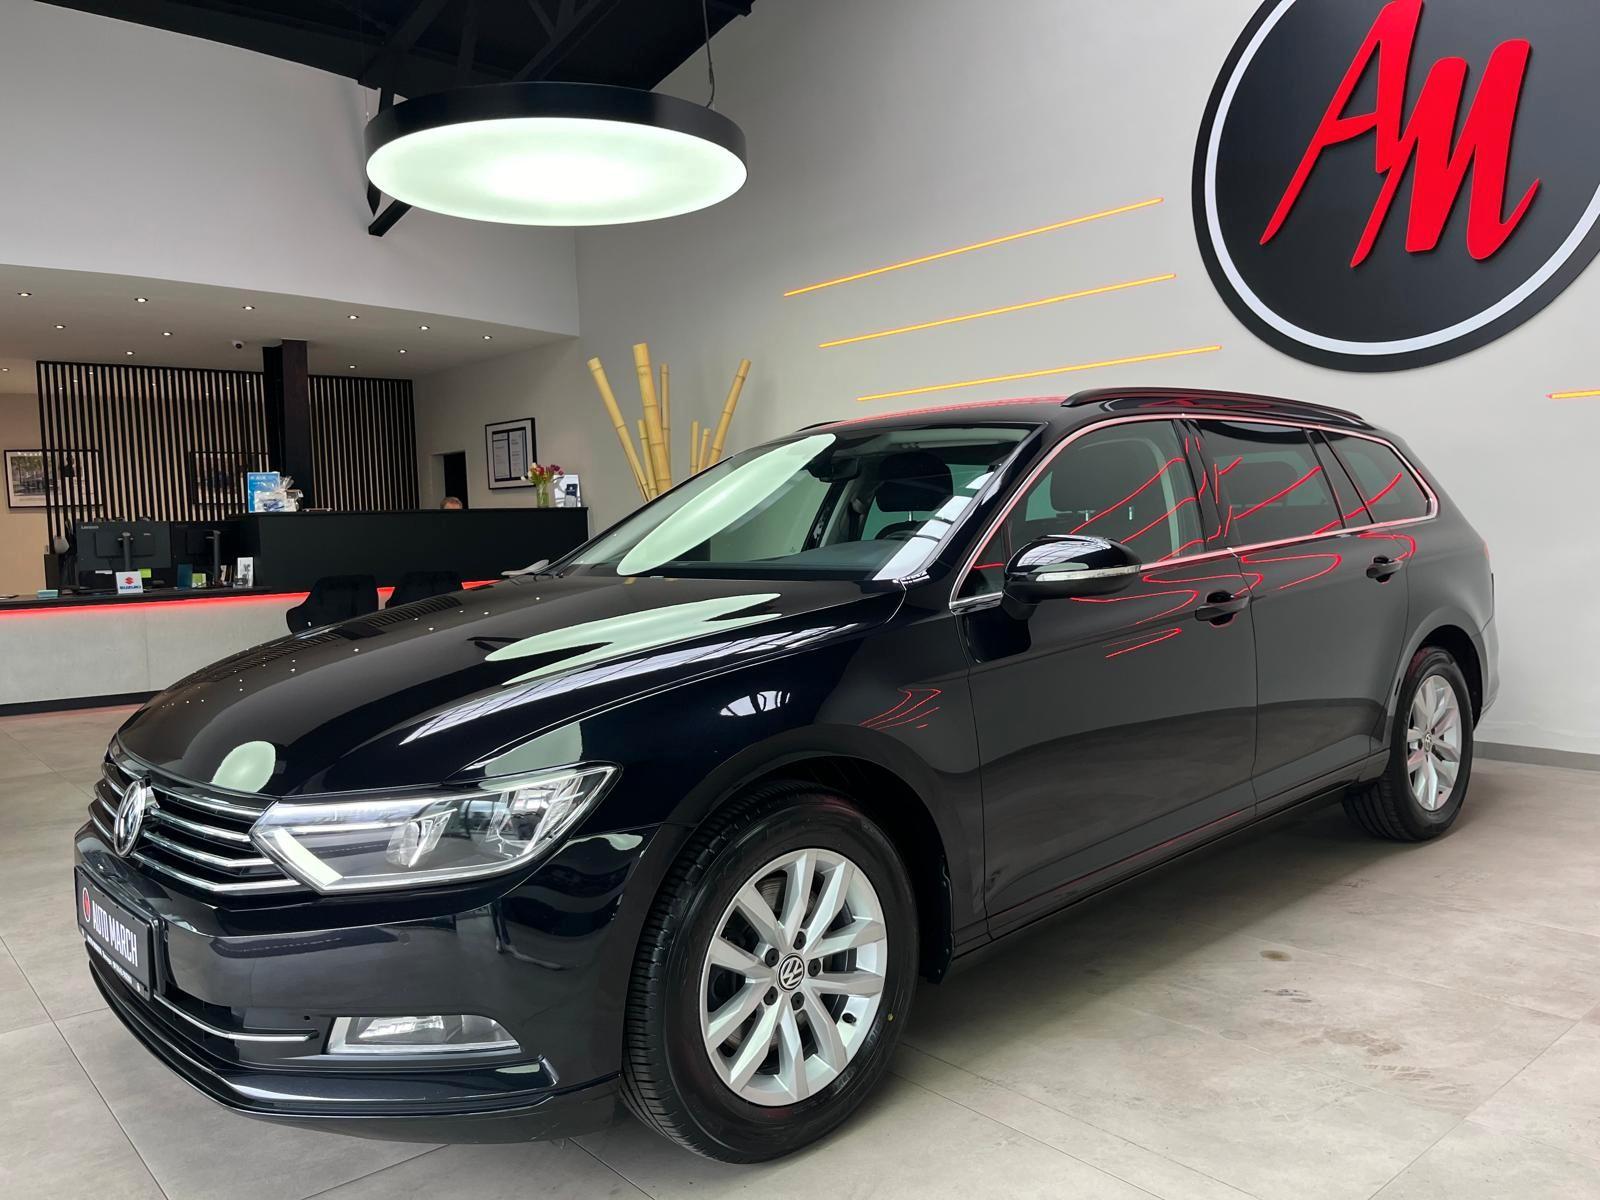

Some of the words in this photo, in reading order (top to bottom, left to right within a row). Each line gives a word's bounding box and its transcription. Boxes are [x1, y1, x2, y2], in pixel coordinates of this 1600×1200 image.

[1260, 0, 1541, 268] AM
[91, 900, 110, 943] AUTO
[108, 914, 139, 968] MARCH
